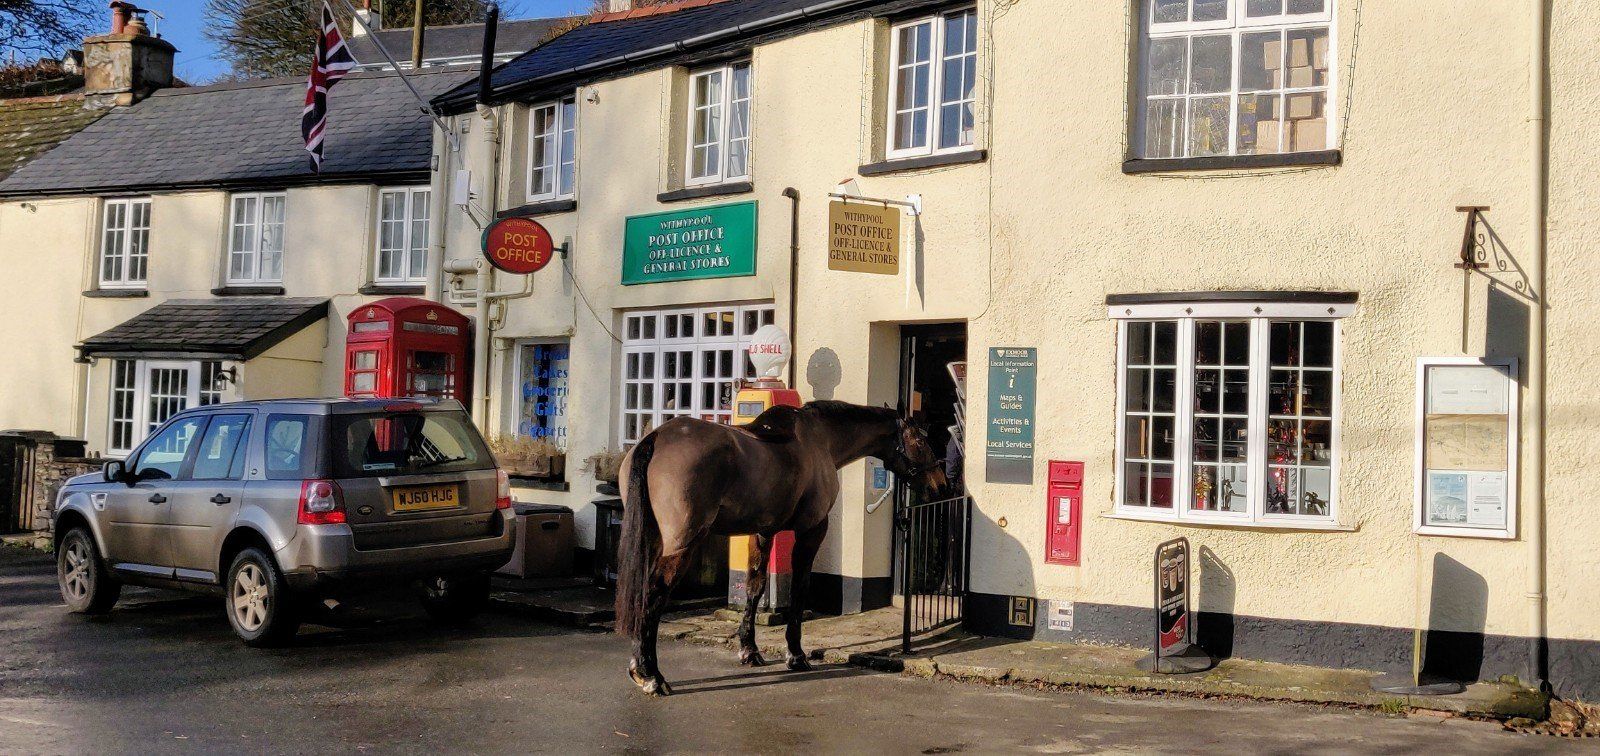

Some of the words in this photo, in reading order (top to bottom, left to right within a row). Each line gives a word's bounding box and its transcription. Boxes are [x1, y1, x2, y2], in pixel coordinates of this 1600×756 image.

[660, 214, 713, 230] WITHYPOOL
[844, 212, 883, 224] WITHYPOOL
[648, 232, 679, 247] POST
[682, 226, 724, 244] OFFICE
[834, 223, 857, 236] POST
[860, 226, 892, 239] OFFICE
[504, 232, 539, 248] POST
[834, 238, 884, 251] OFF-LICENCE
[886, 242, 892, 252] &
[496, 246, 542, 264] OFFICE
[649, 243, 711, 261] OFF-LICENCE
[714, 243, 722, 254] &
[830, 250, 867, 262] GENERAL
[869, 254, 897, 265] STORES
[643, 260, 687, 275] GENERAL
[690, 255, 730, 271] STORES
[760, 344, 782, 354] SHELL
[1000, 394, 1016, 402] Maps
[1000, 425, 1021, 434] Events
[987, 440, 1004, 448] Local
[1005, 440, 1032, 449] Services
[400, 491, 429, 506] WJ60
[431, 489, 453, 503] HJG
